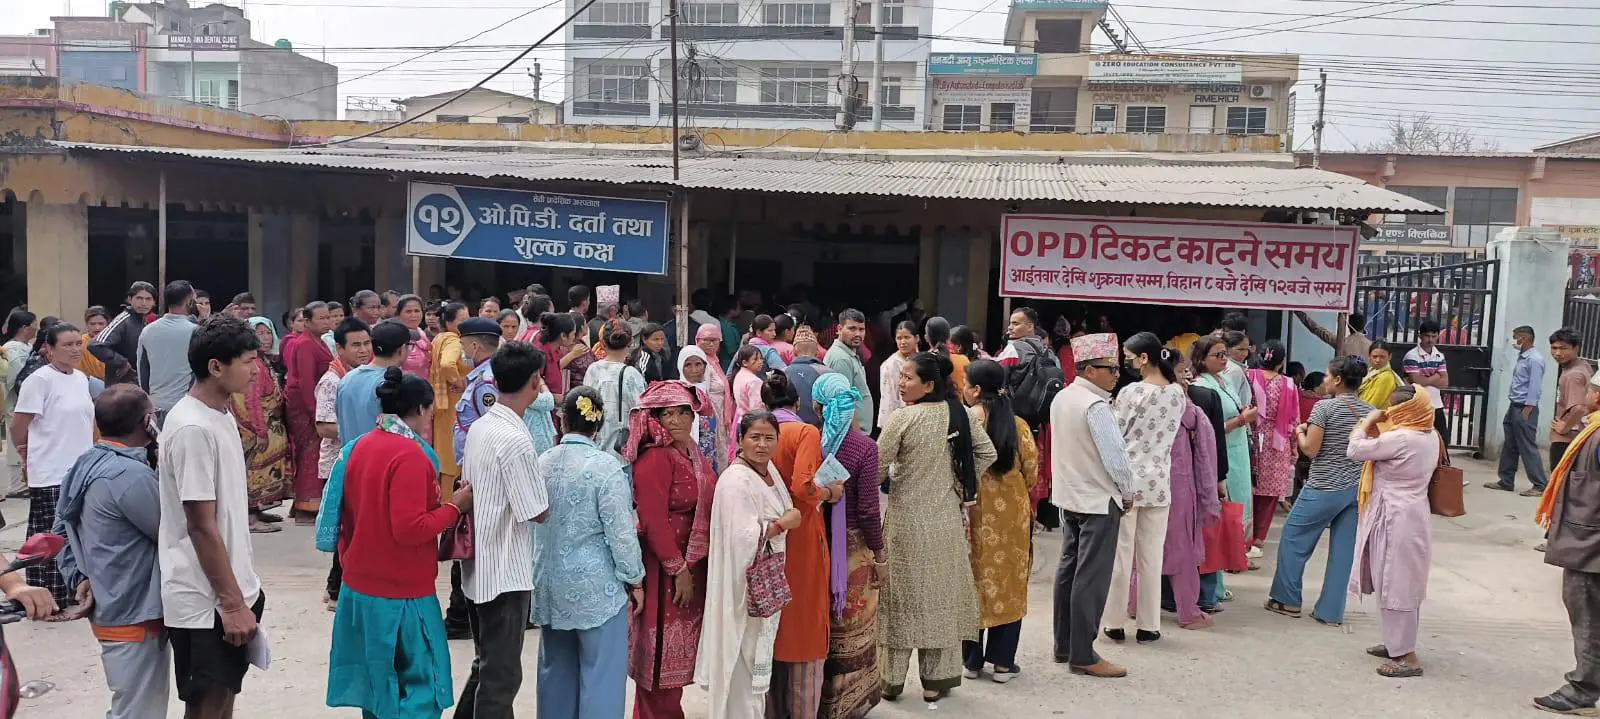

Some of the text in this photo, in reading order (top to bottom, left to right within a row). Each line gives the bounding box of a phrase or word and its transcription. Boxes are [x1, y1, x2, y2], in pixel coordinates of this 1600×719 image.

[1194, 94, 1239, 103] AMERICA
[418, 204, 461, 235] १२
[479, 203, 653, 237] ओ.पि.डी. दर्ता तथा
[1407, 228, 1448, 239] क्लिनिक
[513, 236, 616, 263] शुल्क कक्ष
[1009, 230, 1087, 259] OPD
[1089, 224, 1175, 263] टिकट
[1265, 239, 1350, 270] समय
[1010, 265, 1060, 286] आईतवार
[1061, 265, 1086, 288] देखि
[1088, 270, 1134, 289] शुक्रवार
[1215, 275, 1238, 291] बजे
[1240, 273, 1267, 296] देखि
[1313, 281, 1346, 297] सम्म
